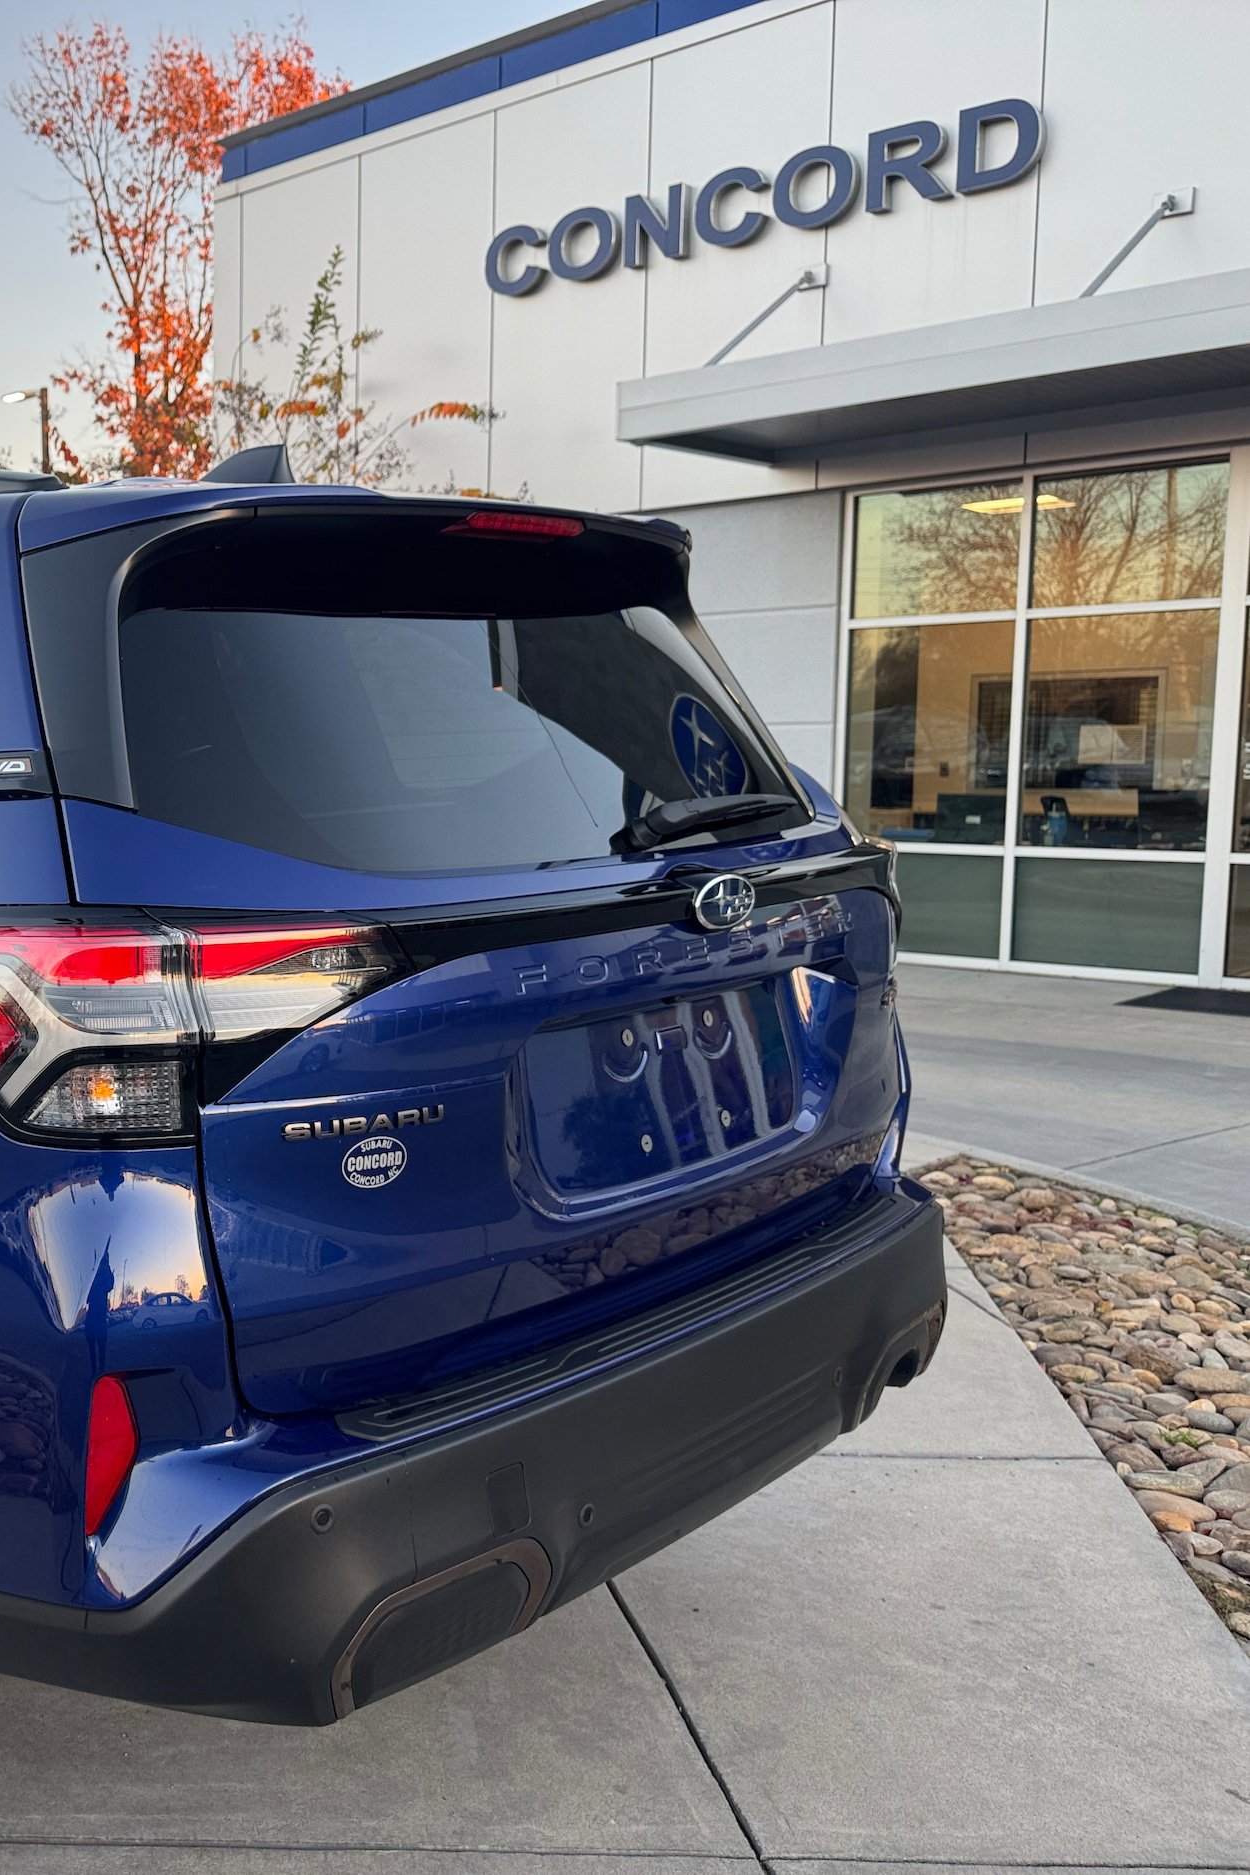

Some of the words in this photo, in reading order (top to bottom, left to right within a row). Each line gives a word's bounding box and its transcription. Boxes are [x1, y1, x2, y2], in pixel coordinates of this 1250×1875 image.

[485, 98, 1046, 297] CONCORD
[282, 1104, 445, 1141] SUBARU
[360, 1139, 393, 1152] SUBARU
[347, 1150, 403, 1171] CONCORD
[350, 1172, 385, 1185] CONCORD
[387, 1165, 399, 1178] NC
